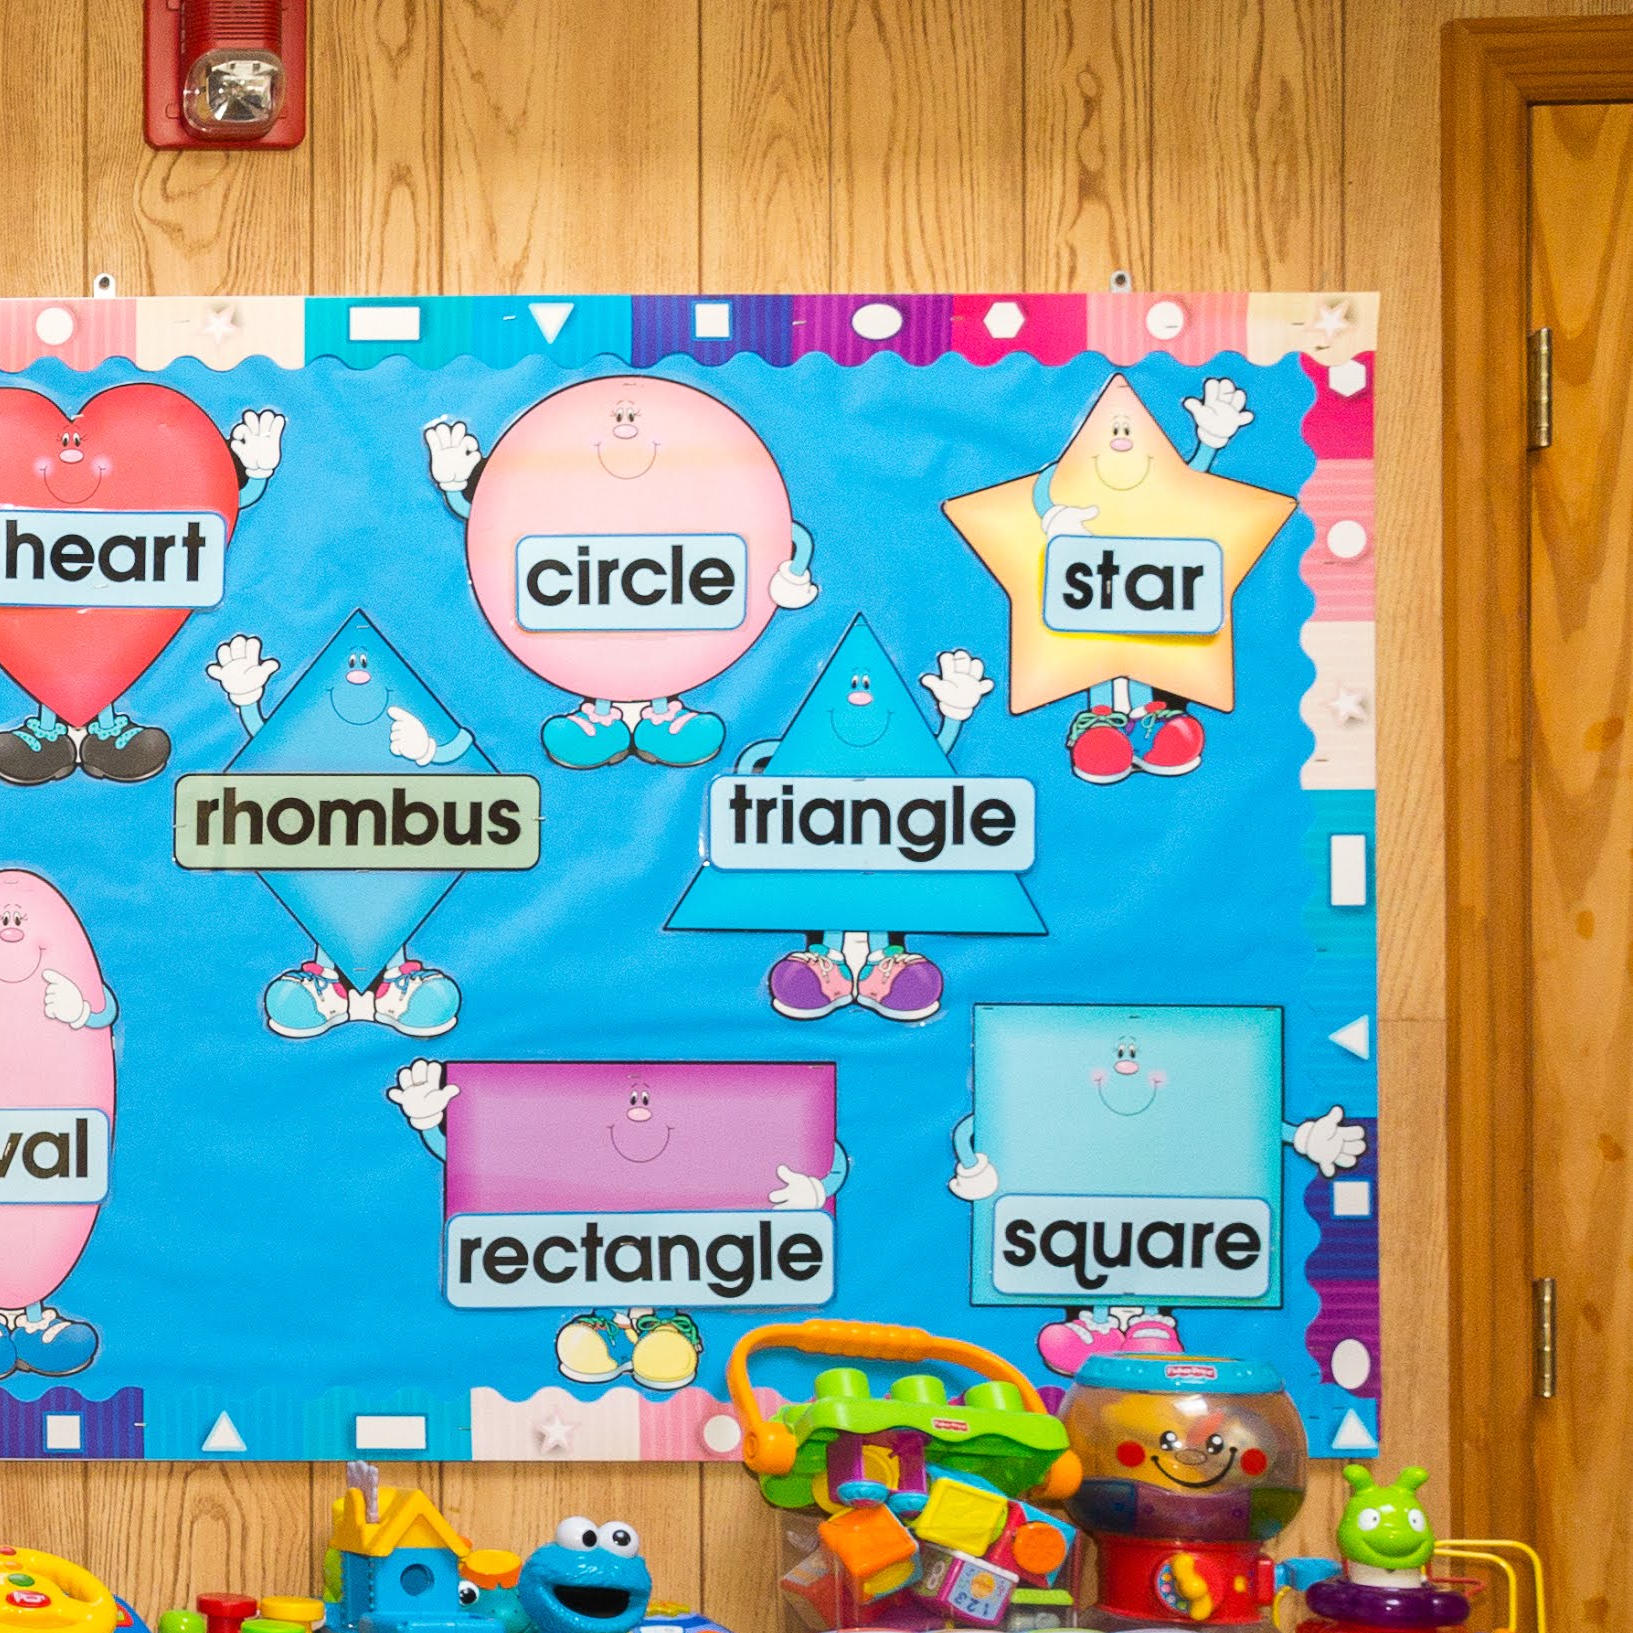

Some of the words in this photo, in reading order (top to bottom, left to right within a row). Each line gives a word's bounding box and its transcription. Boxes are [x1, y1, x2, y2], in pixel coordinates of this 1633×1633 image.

[4, 519, 206, 583] heart
[527, 543, 737, 609] circle
[1062, 550, 1204, 614] star
[194, 786, 521, 848] rhombus
[729, 784, 1017, 863] triangle
[459, 1221, 824, 1298] rectangle
[1002, 1217, 1261, 1289] square
